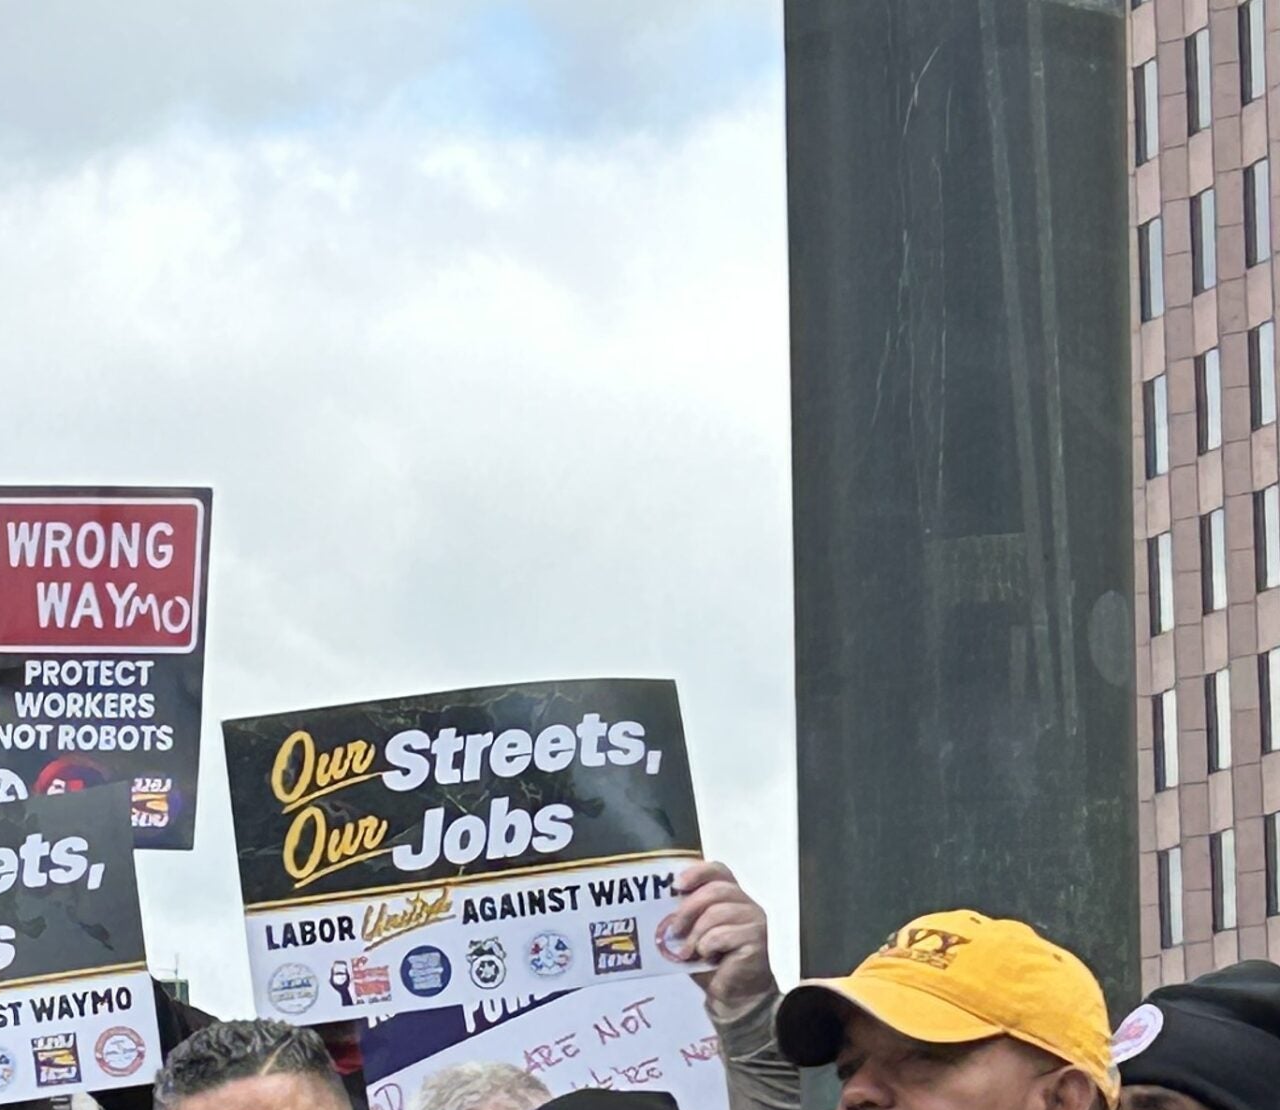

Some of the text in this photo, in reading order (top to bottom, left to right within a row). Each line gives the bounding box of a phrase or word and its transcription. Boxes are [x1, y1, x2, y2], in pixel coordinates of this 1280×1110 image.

[6, 521, 174, 569] WRONG
[36, 582, 191, 635] WAYMO
[24, 660, 155, 686] PROTECT
[14, 692, 155, 718] WORKERS
[57, 725, 174, 751] ROBOTS
[270, 713, 662, 808] Our Streets,
[282, 797, 575, 885] Our Jobs
[265, 915, 355, 950] LABOR
[462, 883, 580, 925] AGAINST
[588, 872, 678, 907] WAYM
[31, 985, 132, 1023] WAYMO
